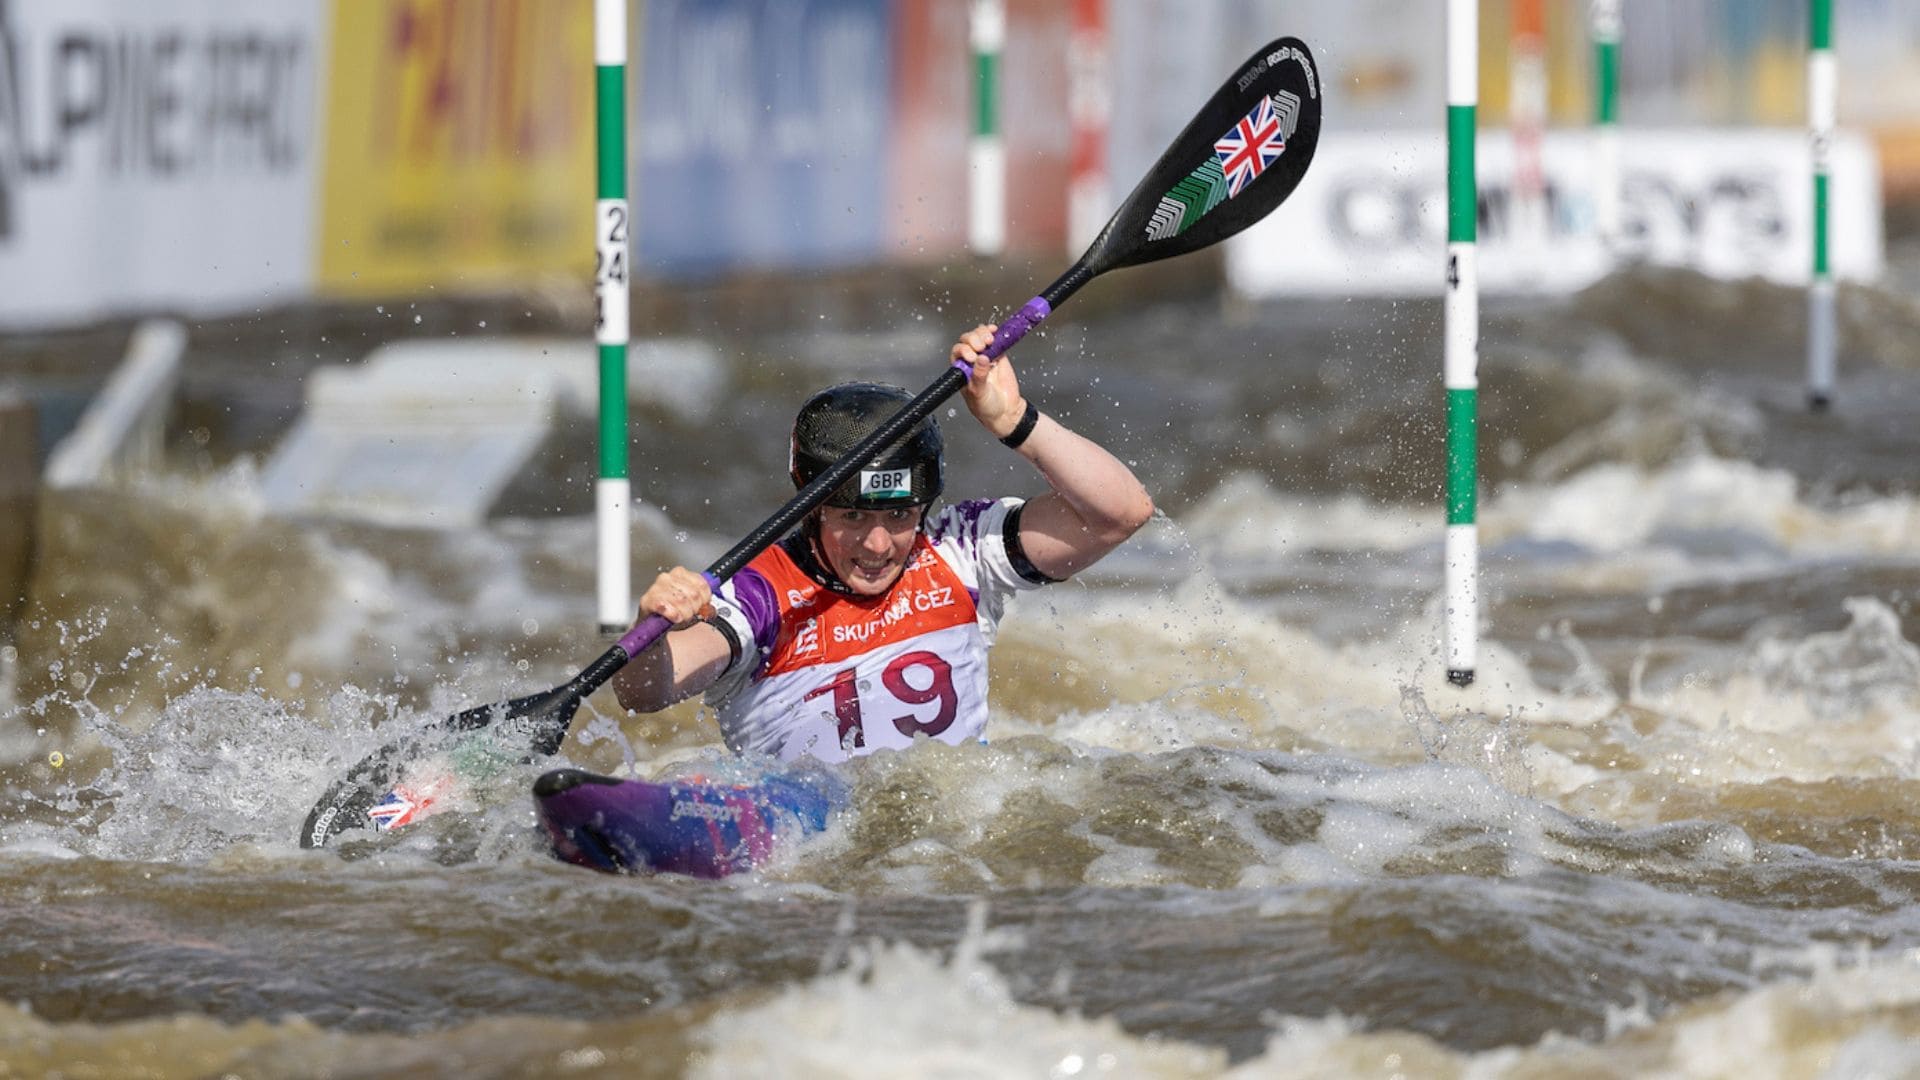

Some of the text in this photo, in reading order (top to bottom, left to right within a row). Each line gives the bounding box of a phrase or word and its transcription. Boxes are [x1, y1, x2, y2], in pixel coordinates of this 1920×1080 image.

[870, 472, 904, 489] GBR
[914, 586, 955, 612] ČEZ
[803, 650, 959, 751] 19
